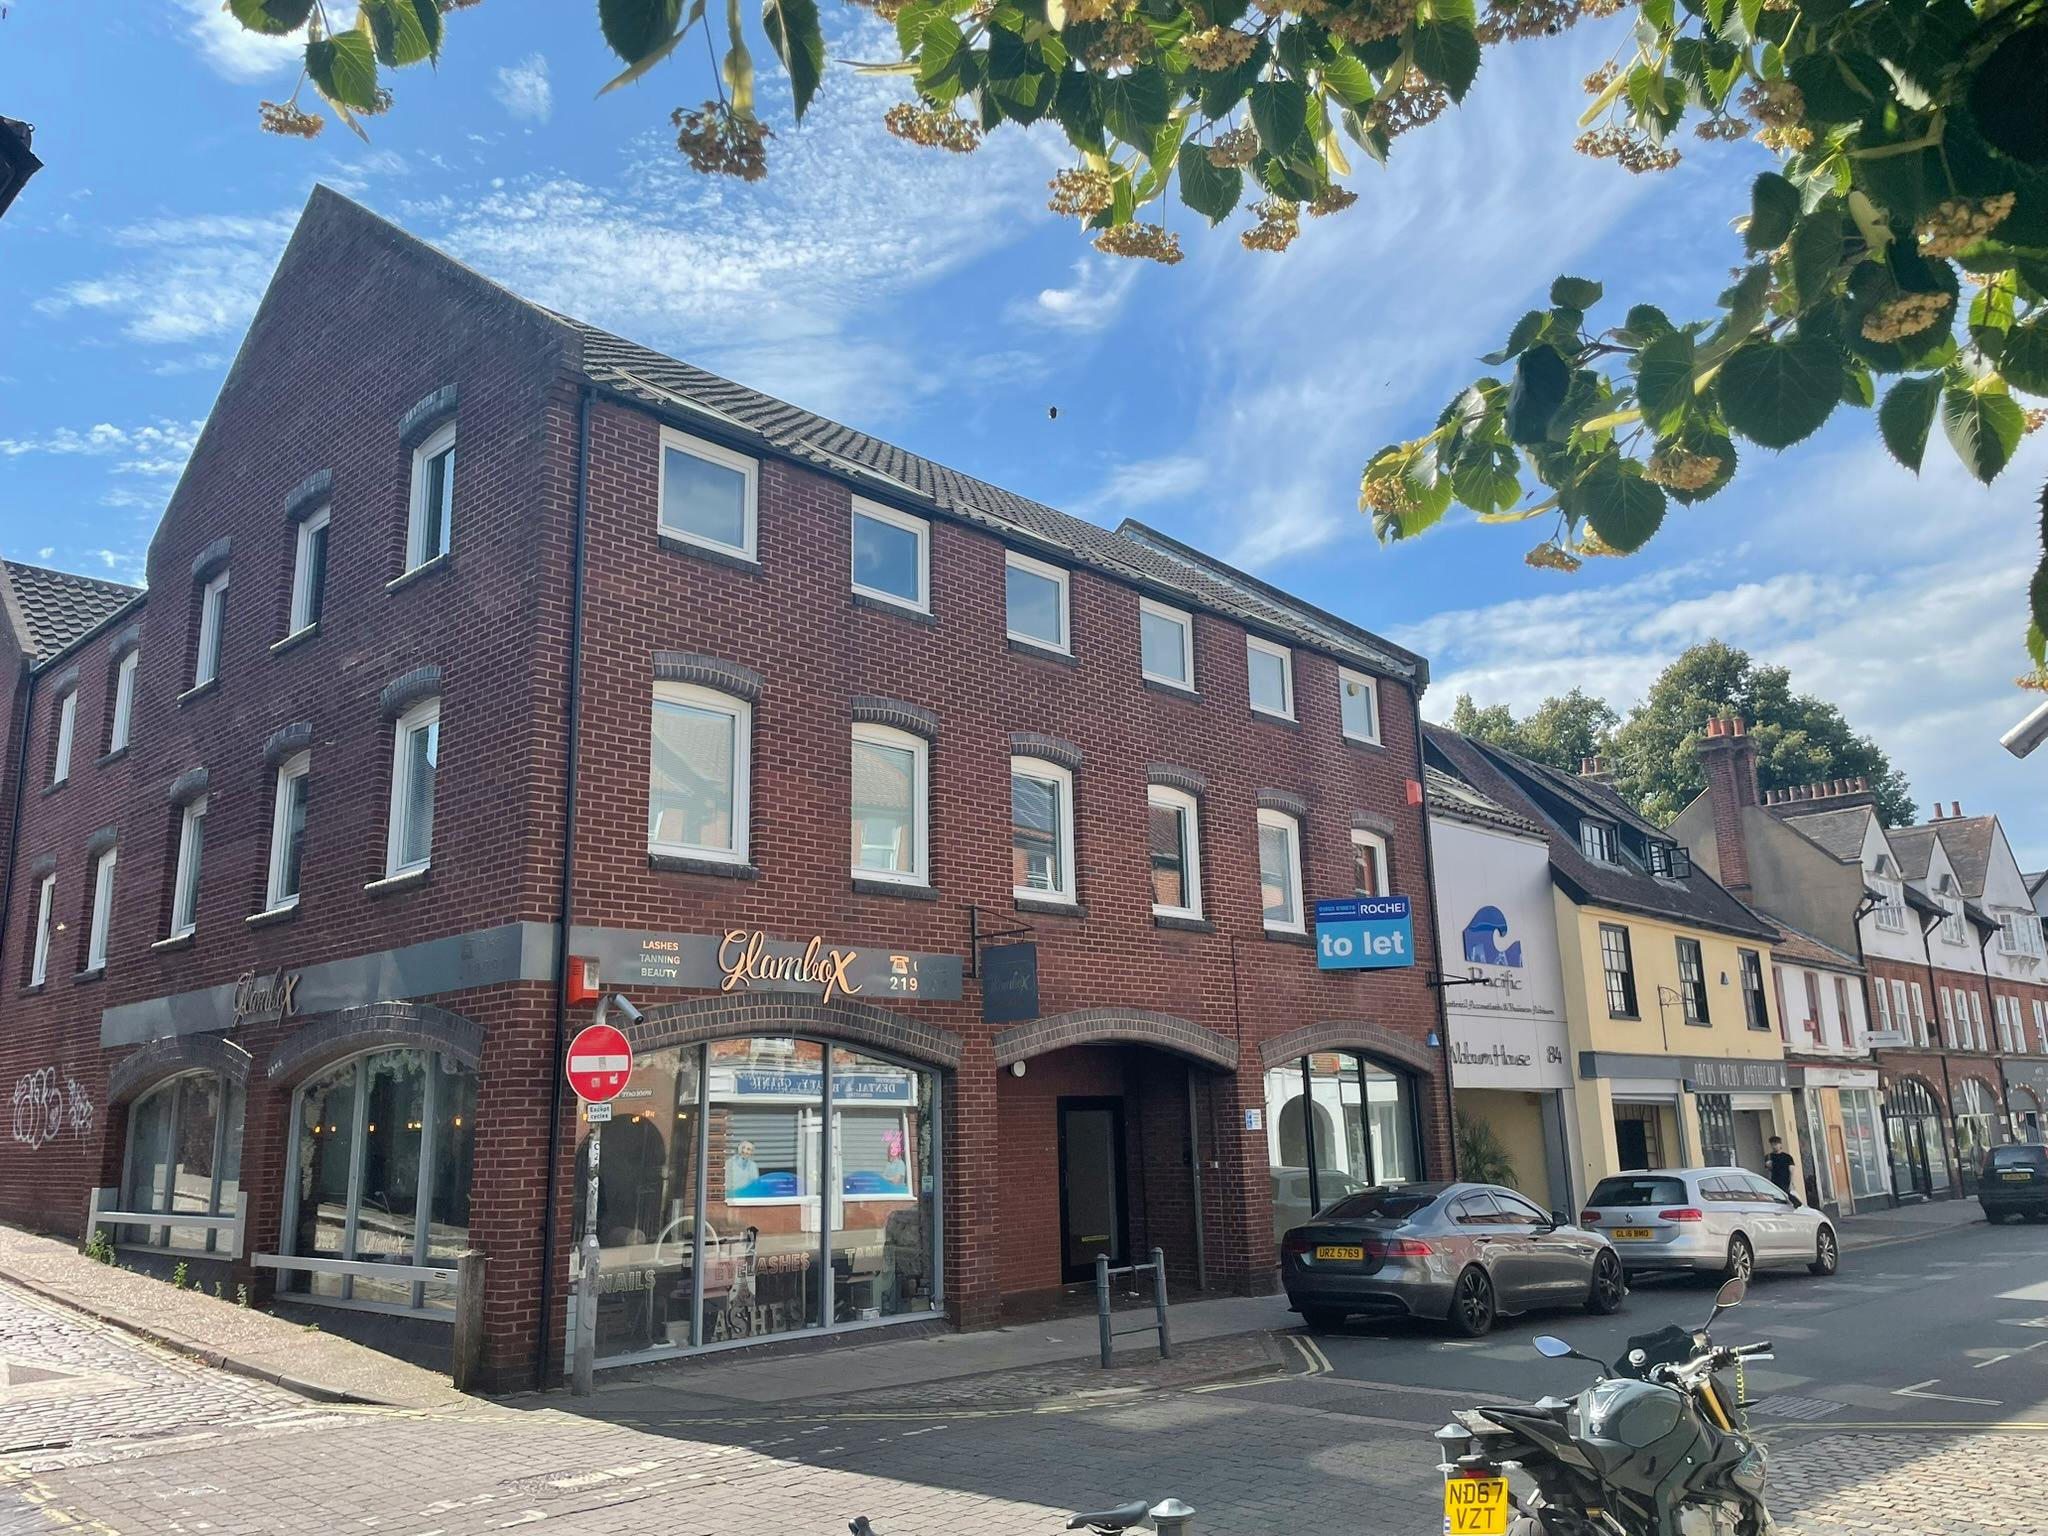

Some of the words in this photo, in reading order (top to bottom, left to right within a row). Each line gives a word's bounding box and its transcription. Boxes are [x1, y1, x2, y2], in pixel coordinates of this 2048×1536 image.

[1360, 902, 1402, 914] ROCHE
[642, 939, 679, 951] LASHES
[1321, 934, 1353, 957] to
[1363, 930, 1405, 956] let
[639, 953, 681, 966] TANNING
[641, 966, 678, 979] BEAUTY
[889, 976, 918, 991] 219
[1546, 1045, 1562, 1064] 84
[589, 1105, 610, 1114] Except
[1337, 1248, 1360, 1258] 5769
[714, 1252, 811, 1281] EYELASHES
[598, 1269, 656, 1294] NAILS
[1449, 1481, 1504, 1505] ND67
[1456, 1507, 1496, 1529] VZT
